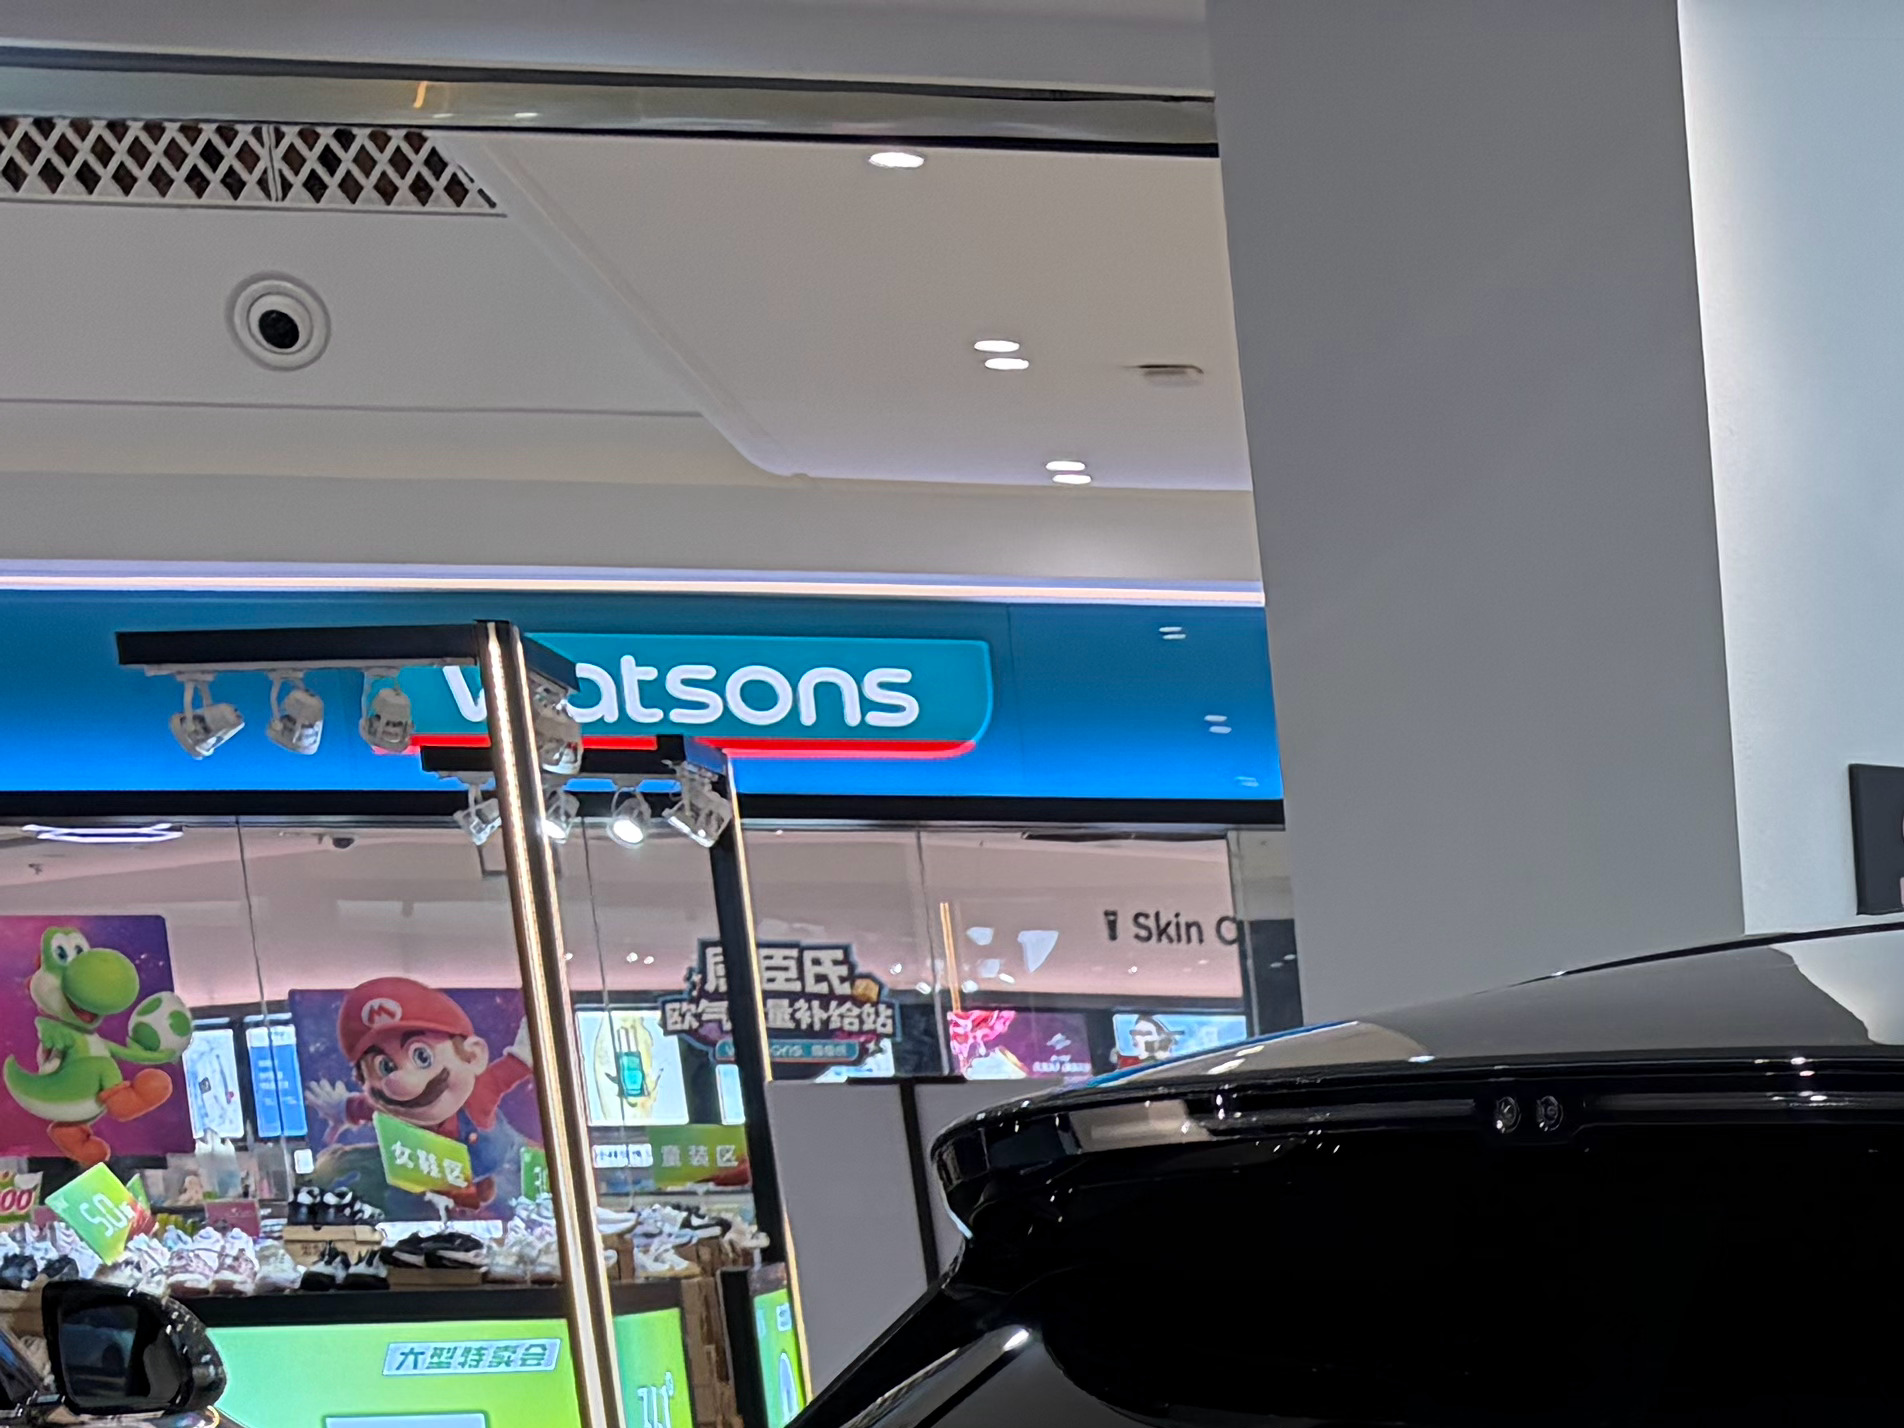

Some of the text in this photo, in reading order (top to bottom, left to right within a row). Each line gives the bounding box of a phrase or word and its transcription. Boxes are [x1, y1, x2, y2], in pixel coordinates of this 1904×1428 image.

[1133, 910, 1203, 945] Skin
[665, 998, 893, 1034] 欧气量补给站
[390, 1141, 468, 1188] 女鞋区
[660, 1144, 739, 1169] 童装区
